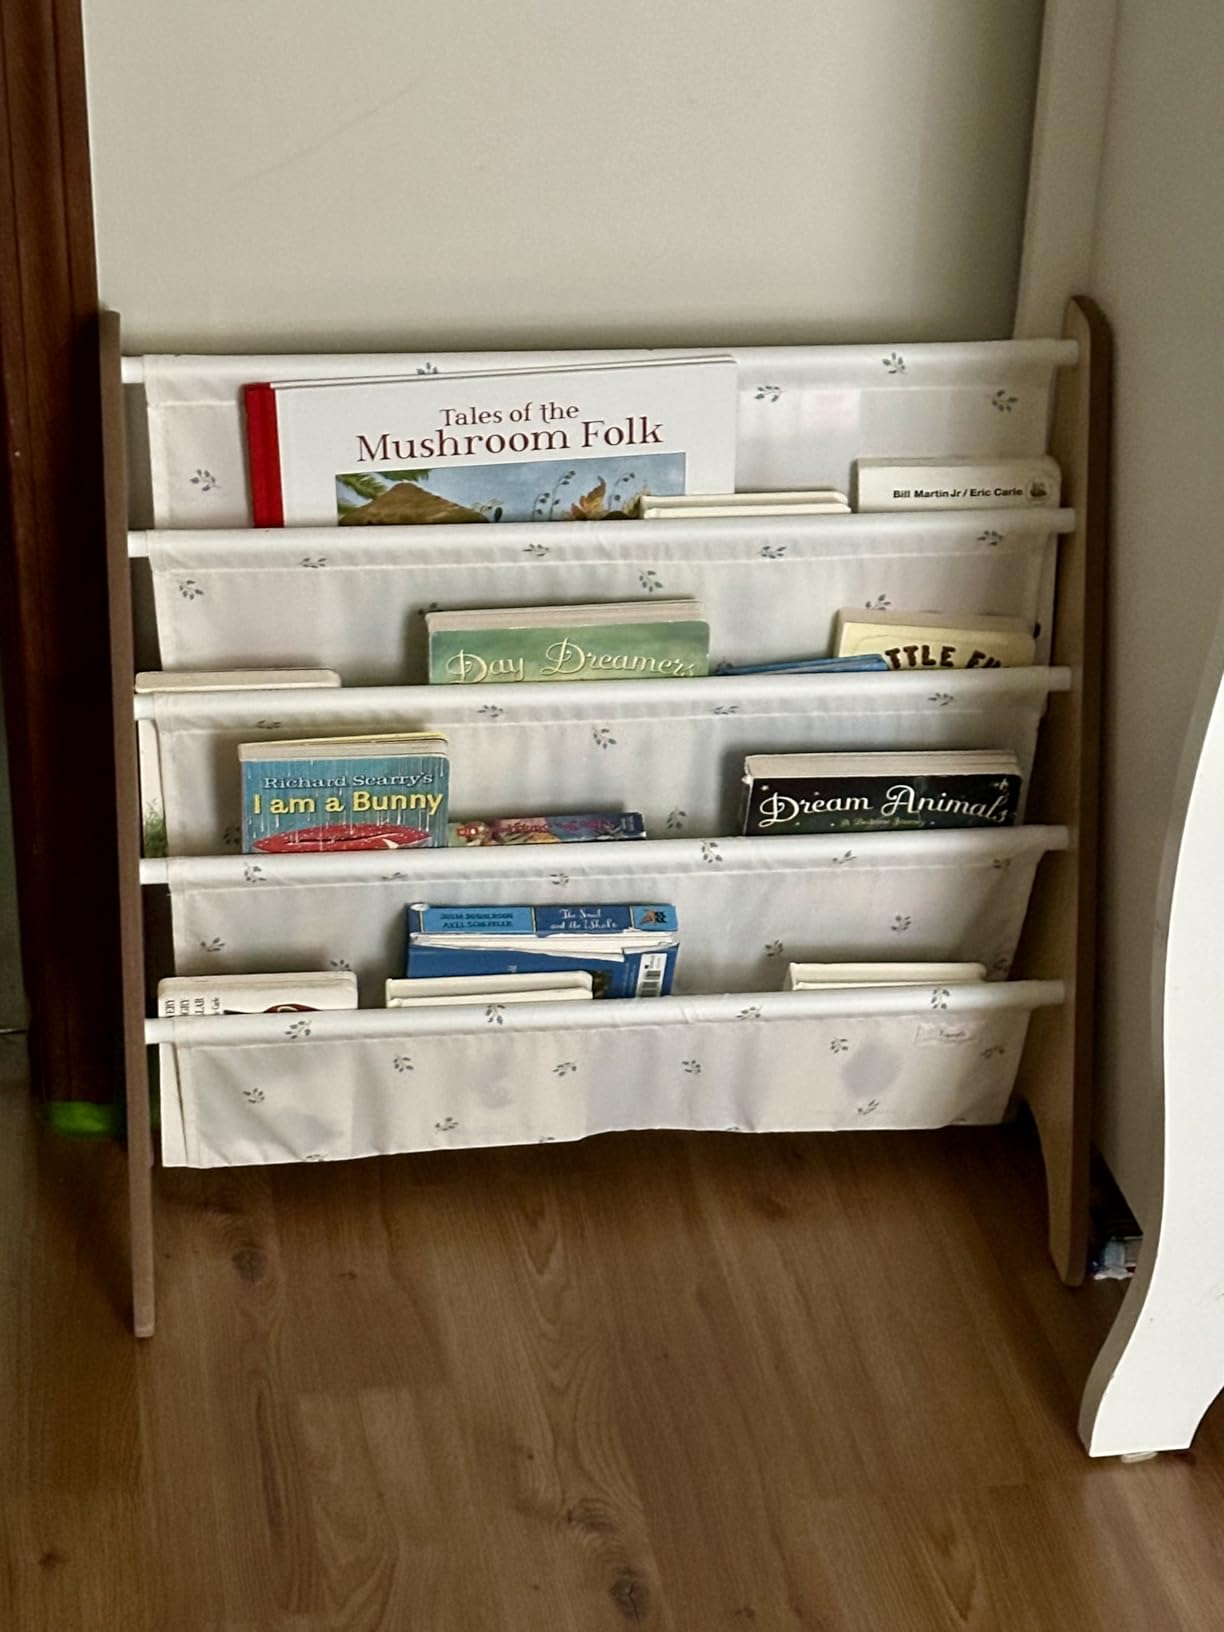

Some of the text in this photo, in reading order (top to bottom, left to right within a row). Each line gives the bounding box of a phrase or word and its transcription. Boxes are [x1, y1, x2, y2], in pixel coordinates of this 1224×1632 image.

[440, 401, 580, 427] Tales of the
[356, 415, 664, 463] Mushroom Folk
[893, 489, 910, 499] Bill
[914, 489, 949, 499] Martin
[950, 488, 962, 498] Jr
[970, 488, 991, 498] Eric
[993, 487, 1024, 497] Carle
[446, 637, 696, 684] Day Dreamers
[885, 644, 956, 670] TTLE
[263, 771, 434, 790] Richard Scarry's
[253, 791, 444, 816] I am a Bunny
[758, 784, 1009, 829] Dream Animals
[165, 999, 175, 1017] ERY
